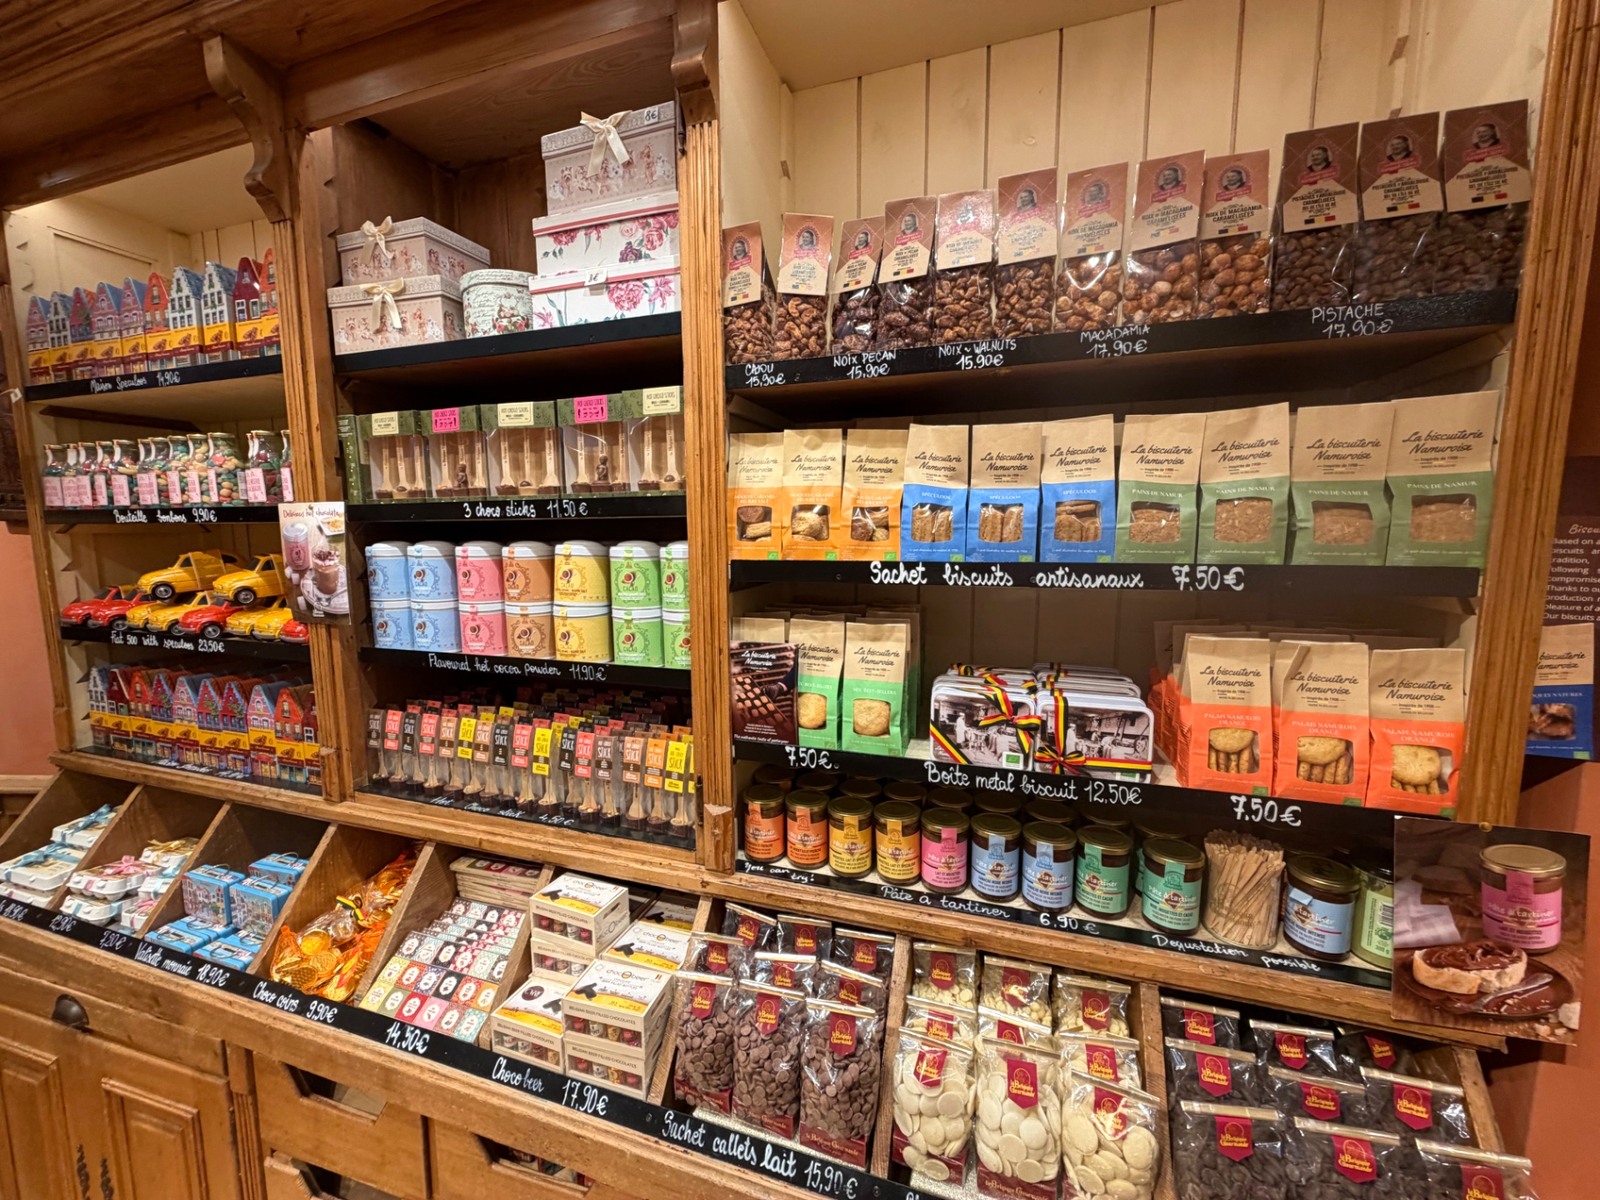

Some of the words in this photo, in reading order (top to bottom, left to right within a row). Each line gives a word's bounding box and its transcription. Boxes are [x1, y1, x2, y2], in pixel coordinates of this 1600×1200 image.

[1080, 326, 1151, 343] MACADAMIA
[861, 350, 897, 363] PECAN
[939, 346, 962, 361] NOIX
[973, 339, 1017, 357] WALNUTS
[744, 362, 774, 377] CAJOU
[1402, 431, 1423, 443] La
[1425, 429, 1484, 442] biscuiterie
[1050, 446, 1065, 457] La
[1066, 445, 1107, 456] biscuiterie
[1131, 444, 1146, 454] La
[1148, 444, 1193, 455] biscuiterie
[1212, 441, 1228, 452] La
[1230, 437, 1280, 450] biscuiterie
[1409, 443, 1473, 455] Namuroise
[852, 455, 865, 464] La
[866, 454, 900, 465] biscuiterie
[915, 451, 927, 460] La
[928, 451, 962, 463] biscuiterie
[1056, 456, 1102, 467] Namuroise
[1136, 456, 1185, 465] Namuroise
[1218, 450, 1273, 463] Namuroise
[856, 464, 893, 474] Namuroise
[919, 461, 958, 473] Namuroise
[1445, 481, 1478, 489] NAMUR
[305, 508, 314, 518] hot
[315, 508, 340, 517] chocolate
[463, 502, 472, 518] 3
[475, 501, 501, 518] choco
[505, 499, 537, 518] sticks
[113, 509, 148, 524] Bouteille
[156, 509, 187, 523] bonbons
[192, 508, 218, 523] 9,90€
[1552, 557, 1590, 565] radition,
[870, 561, 928, 586] Sachet
[943, 563, 1014, 588] biscuits
[1036, 565, 1144, 589] artisanaux
[1551, 567, 1589, 576] ollowing
[1561, 613, 1595, 621] biscuits
[110, 630, 125, 645] Fiat
[126, 634, 138, 646] 500
[142, 635, 159, 647] with
[1539, 651, 1585, 661] biscuiterie
[428, 653, 471, 672] Flavoured
[474, 659, 491, 673] hot
[493, 664, 522, 675] cocoa
[524, 662, 562, 677] powder
[1199, 664, 1215, 675] La
[1216, 666, 1262, 677] biscuiterie
[1207, 677, 1255, 687] Namuroise
[1290, 671, 1307, 682] La
[1308, 673, 1360, 685] biscuiterie
[1296, 682, 1352, 695] Namuroise
[1377, 678, 1396, 689] La
[1398, 679, 1454, 692] biscuiterie
[1385, 689, 1447, 702] Namuroise
[1309, 727, 1339, 735] ORANGE
[975, 773, 1016, 796] metal
[1019, 775, 1079, 800] biscuit
[744, 862, 765, 874] You
[791, 872, 815, 884] try!
[919, 890, 932, 905] à
[940, 892, 1011, 919] tartiner
[1151, 934, 1249, 958] Degustation
[1260, 953, 1321, 973] possible
[252, 981, 278, 1004] Choco
[275, 993, 300, 1013] coins
[306, 1000, 339, 1024] 9,90€
[385, 1021, 431, 1055] 14,50€
[662, 1110, 706, 1148] Sachet
[711, 1133, 758, 1166] callets
[759, 1144, 797, 1178] lait
